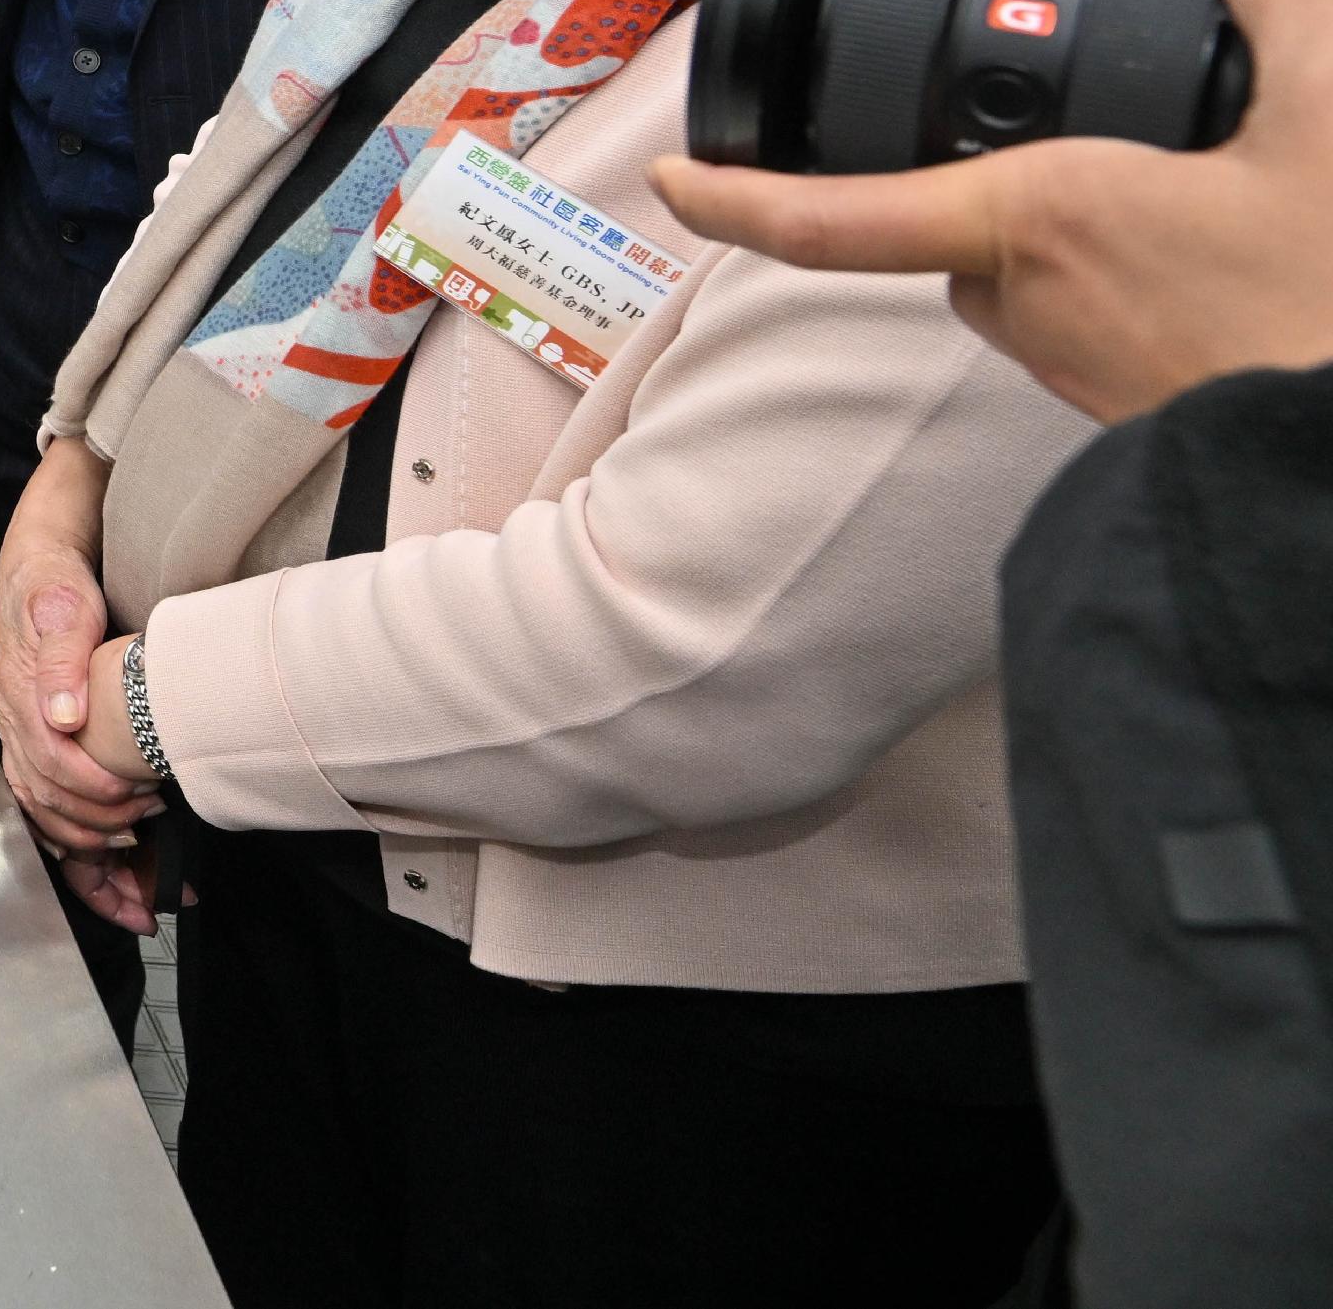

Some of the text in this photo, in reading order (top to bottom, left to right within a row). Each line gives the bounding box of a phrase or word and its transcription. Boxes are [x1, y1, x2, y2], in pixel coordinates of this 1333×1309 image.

[996, 0, 1047, 32] G
[457, 164, 471, 175] Sai
[474, 173, 491, 189] Ying
[493, 185, 510, 199] Pun
[511, 197, 558, 230] Community
[560, 227, 588, 248] Living
[589, 244, 615, 264] Room
[617, 262, 652, 288] Opening
[457, 201, 646, 320] 紀文鳳女士 GBS, JP
[466, 234, 613, 330] 周大福慈善基金理事
